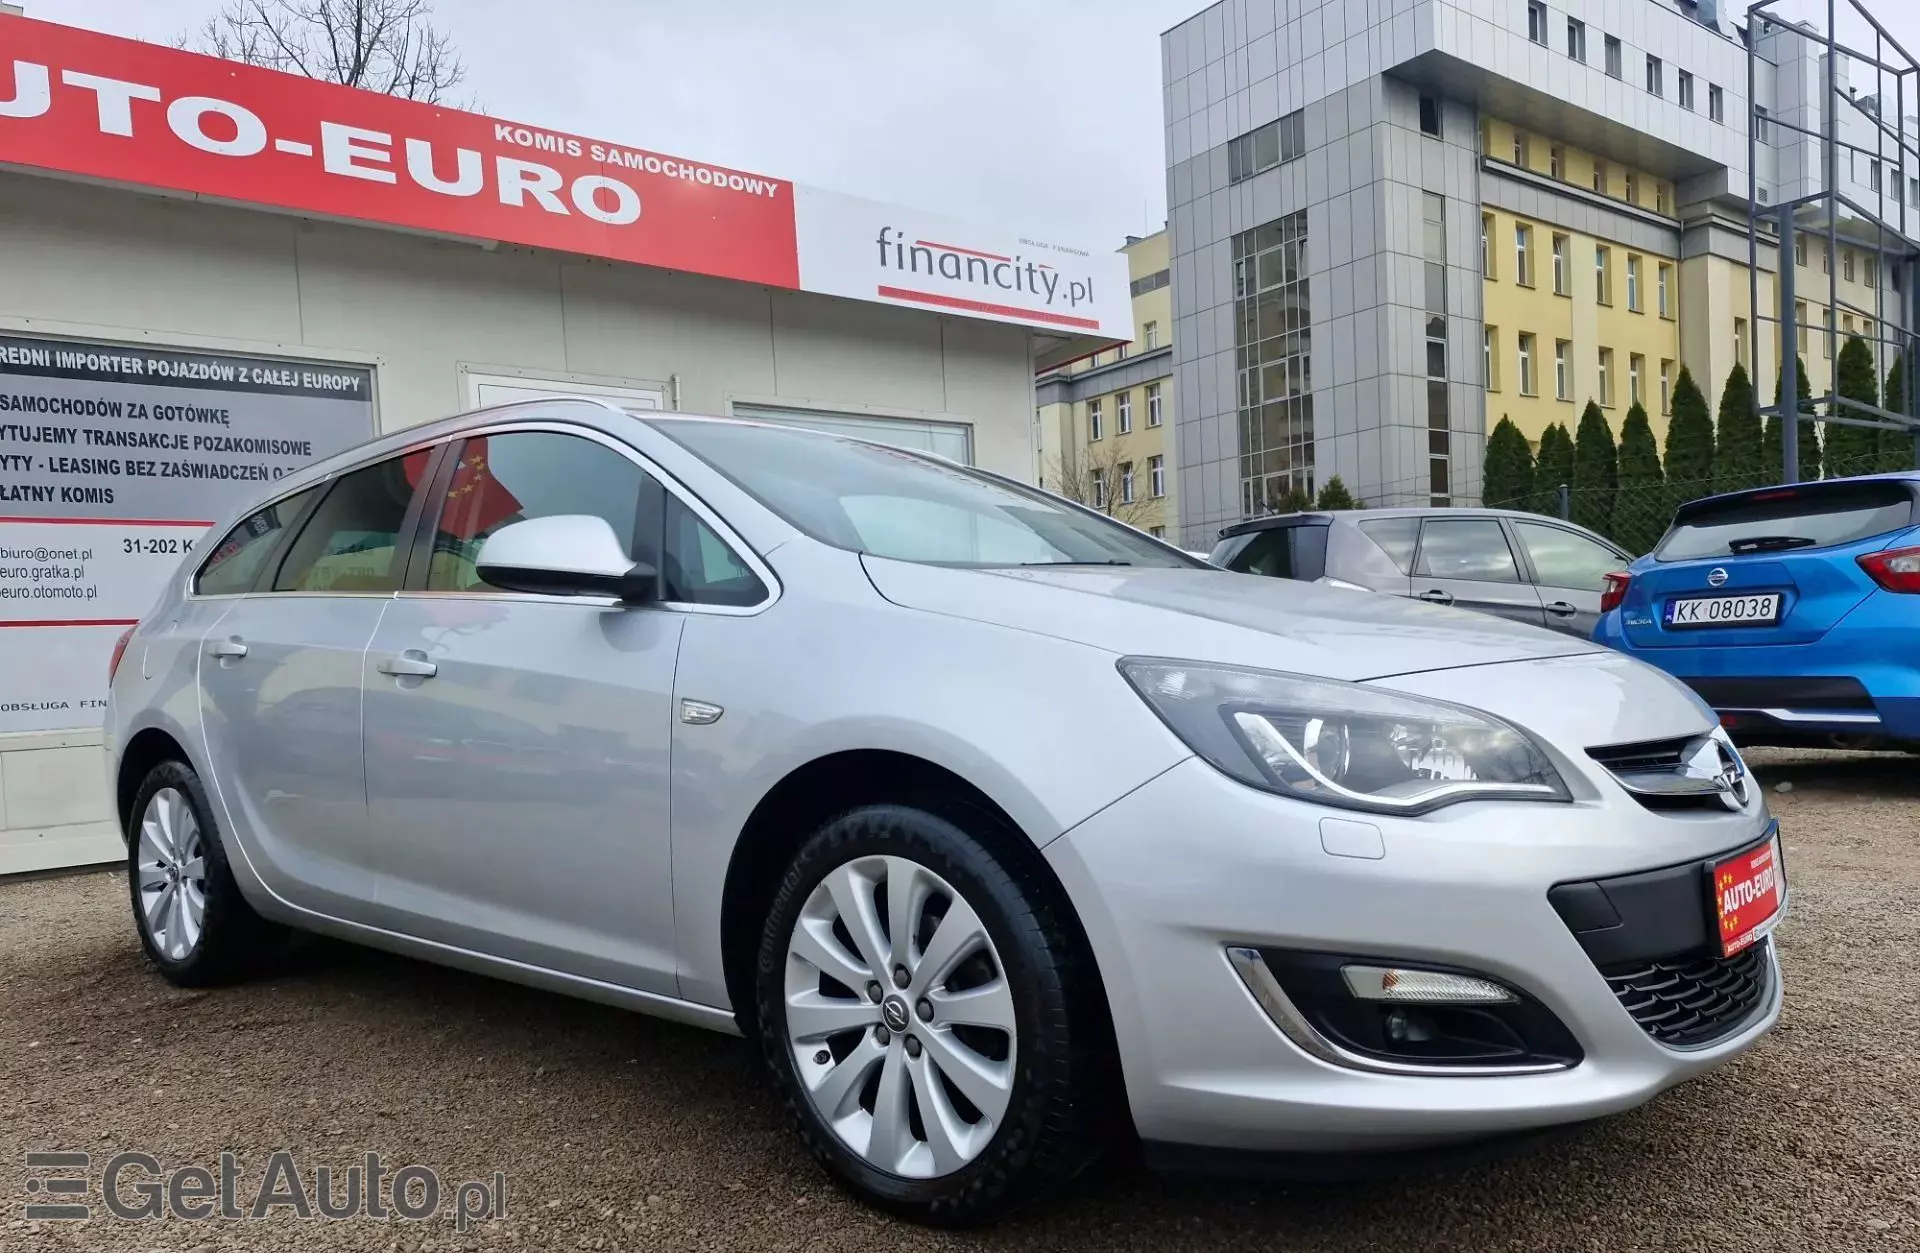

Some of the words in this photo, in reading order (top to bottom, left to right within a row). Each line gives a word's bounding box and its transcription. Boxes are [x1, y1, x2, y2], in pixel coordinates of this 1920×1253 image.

[494, 123, 582, 158] KOMIS
[590, 144, 779, 199] SAMOCHODOWY
[876, 226, 1094, 308] financity.pl
[56, 351, 143, 375] IMPORTER
[148, 359, 234, 382] POJAZDÓW
[238, 367, 249, 383] Z
[252, 369, 299, 388] CAŁEJ
[303, 373, 360, 392] EUROPY
[0, 394, 122, 419] SAMOCHODÓW
[127, 402, 149, 420] ZA
[153, 402, 230, 429] GOTÓWKĘ
[83, 429, 189, 450] TRANSAKCJE
[194, 435, 312, 456] POZAKOMISOWE
[49, 456, 120, 476] LEASING
[126, 460, 156, 477] BEZ
[161, 458, 269, 481] ZAŚWIADCZEŃ
[61, 486, 114, 504] KOMIS
[123, 538, 178, 554] 31-202
[0, 584, 97, 602] euro.otomoto.pl
[1677, 601, 1703, 621] KK
[1709, 597, 1772, 620] 08038
[0, 701, 69, 712] OBSŁUGA
[1723, 866, 1775, 915] AUTO-EURO
